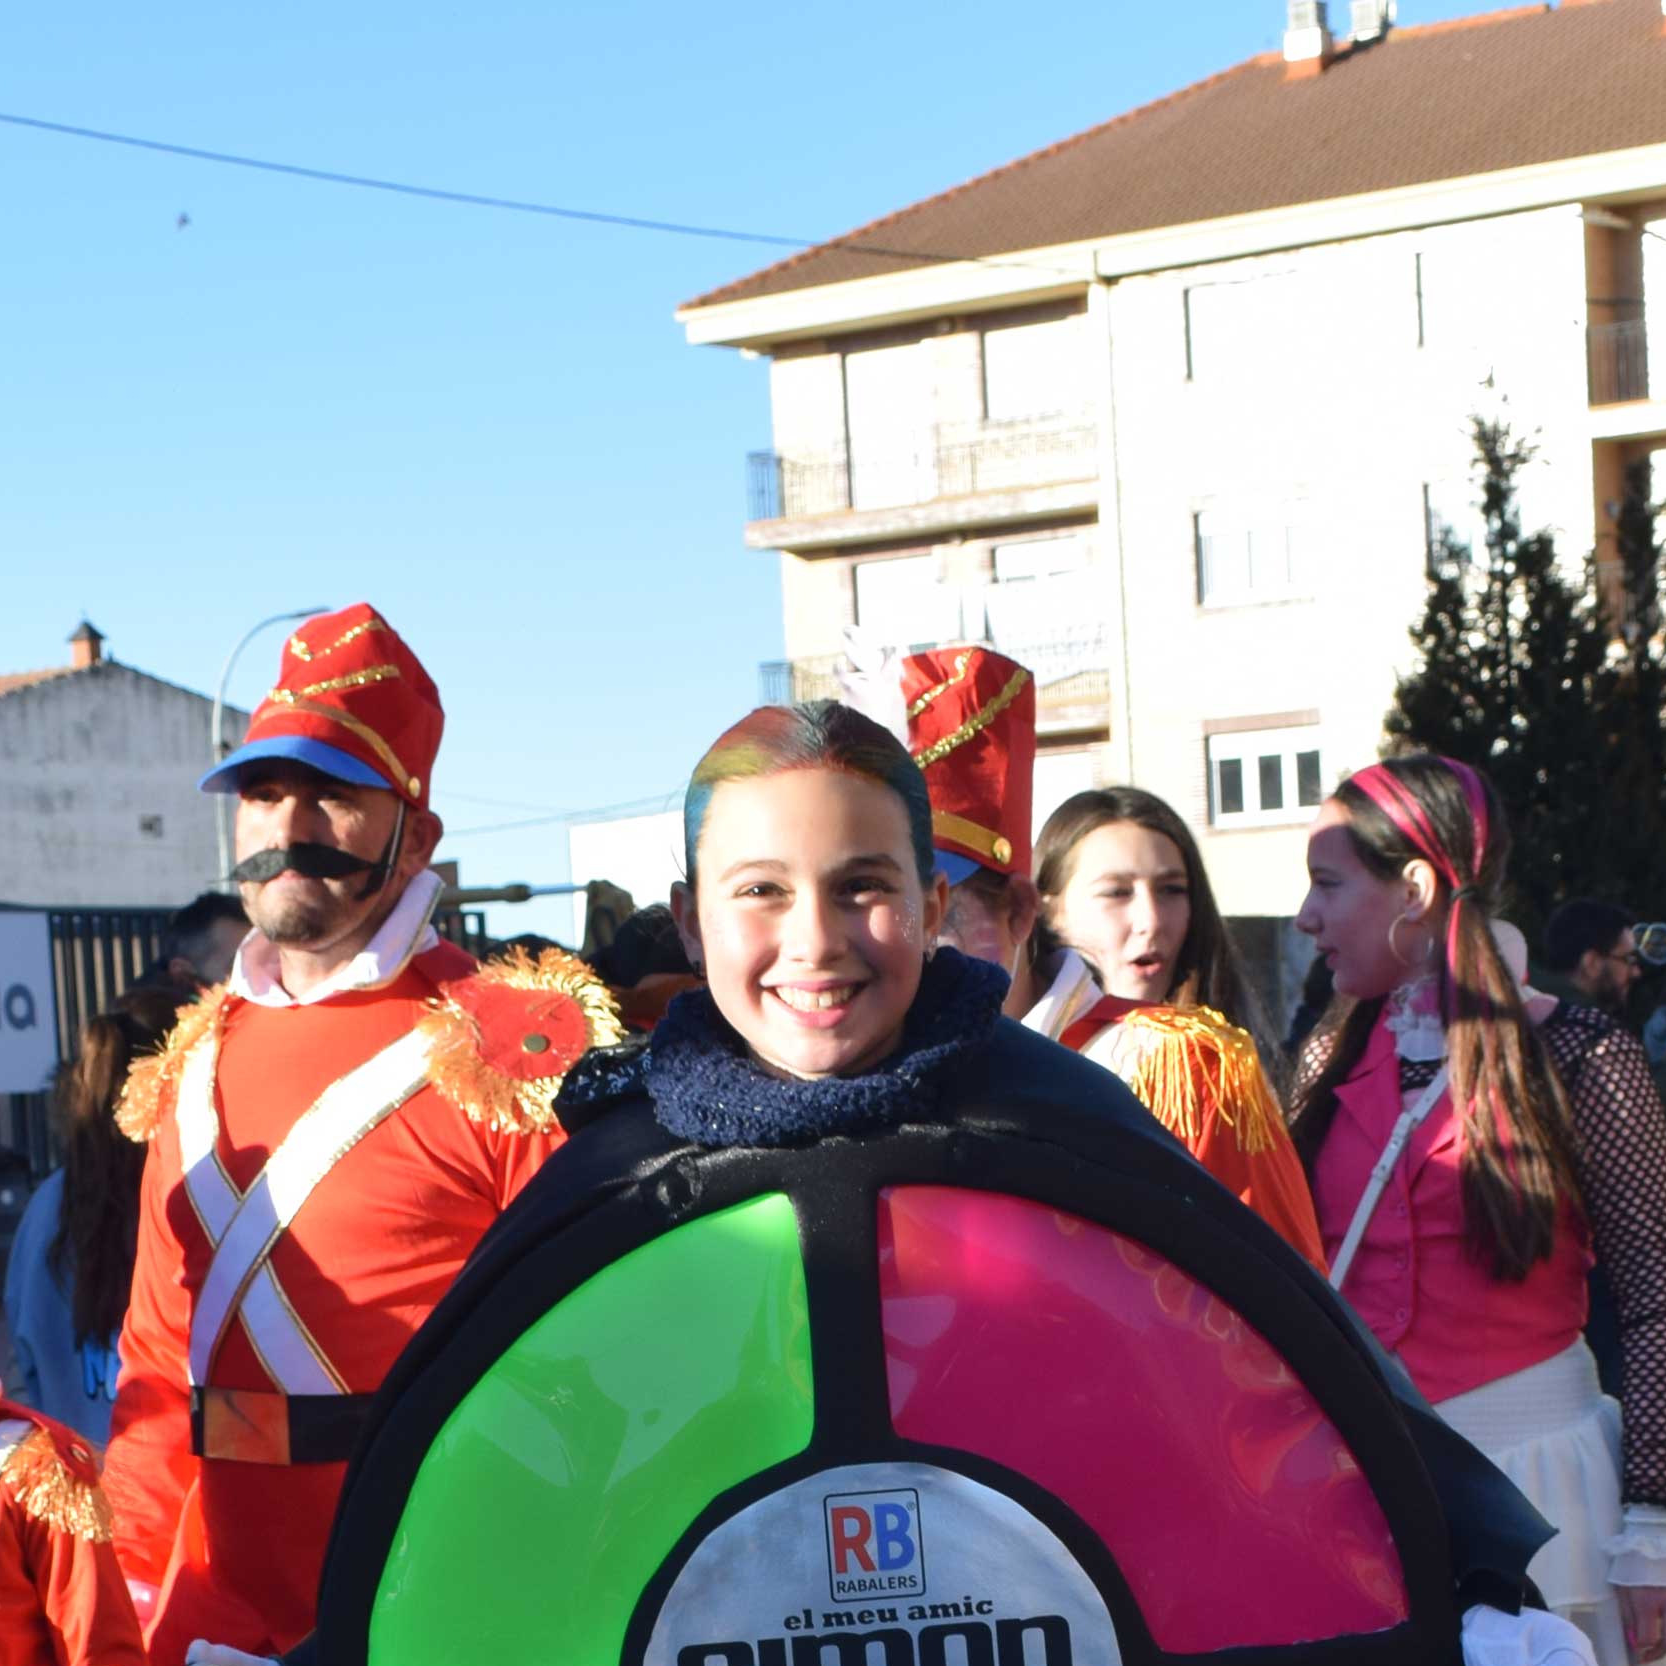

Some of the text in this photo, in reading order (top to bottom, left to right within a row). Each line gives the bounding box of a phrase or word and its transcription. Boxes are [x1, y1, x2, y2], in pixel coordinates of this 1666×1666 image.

[829, 1503, 916, 1575] RB
[836, 1575, 918, 1594] RABALERS
[783, 1595, 994, 1631] el meu amic
